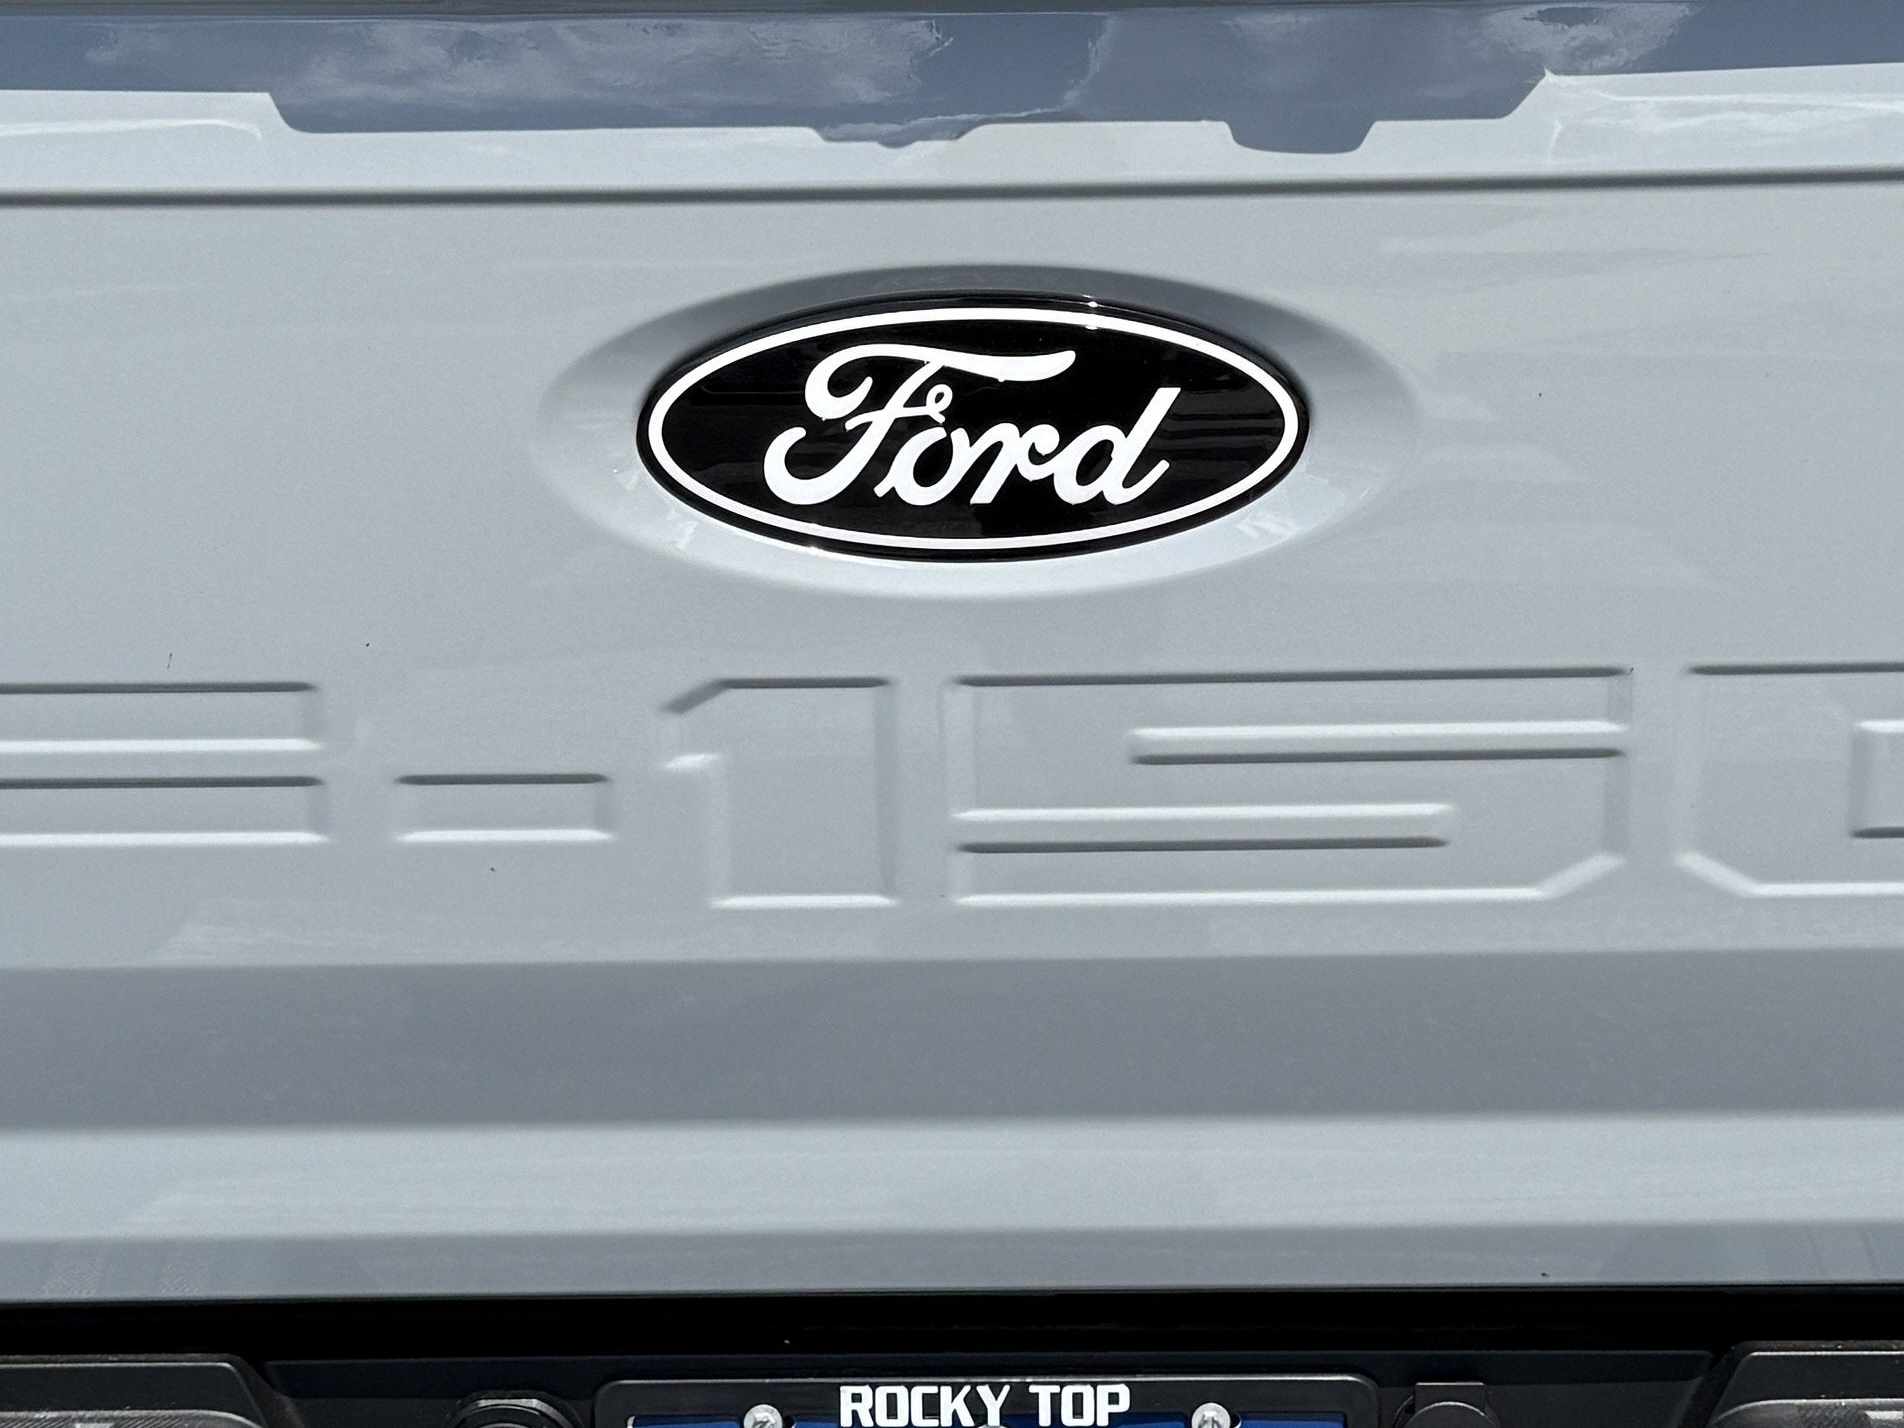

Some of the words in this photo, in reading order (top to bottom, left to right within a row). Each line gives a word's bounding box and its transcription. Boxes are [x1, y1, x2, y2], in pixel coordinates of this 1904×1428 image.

[763, 342, 1182, 508] Ford
[838, 1383, 1012, 1428] ROCKY
[1028, 1383, 1132, 1428] TOP
